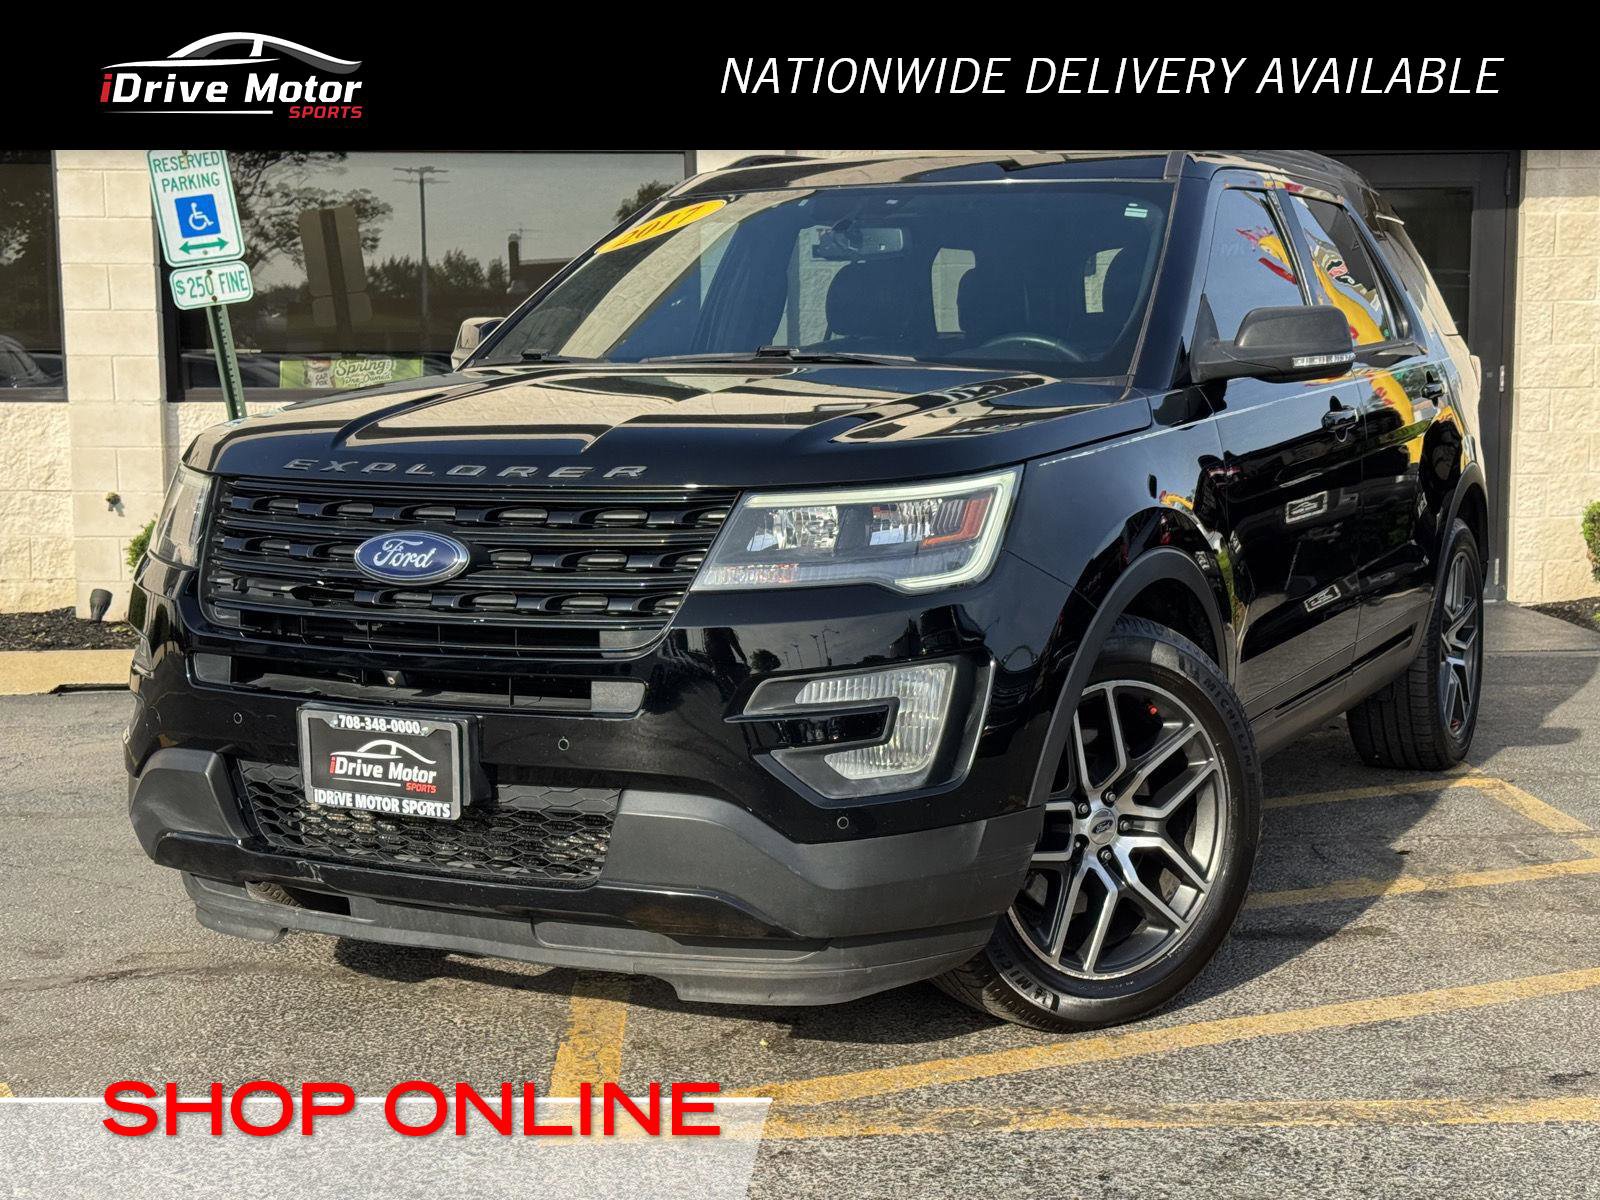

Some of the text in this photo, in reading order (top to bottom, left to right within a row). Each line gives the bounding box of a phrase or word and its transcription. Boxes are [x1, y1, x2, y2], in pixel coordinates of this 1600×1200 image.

[152, 151, 220, 174] RESERVED
[161, 172, 220, 193] PARKING
[611, 204, 706, 249] 2017
[218, 270, 249, 294] FINE
[336, 359, 387, 376] Spring
[283, 458, 648, 479] EXPLORER
[373, 537, 436, 570] Ford
[338, 714, 421, 735] 708-348-0000
[329, 756, 437, 784] iDrive Motor
[405, 782, 437, 794] SPORTS
[355, 794, 400, 813] MOTOR
[403, 801, 451, 819] SPORTS
